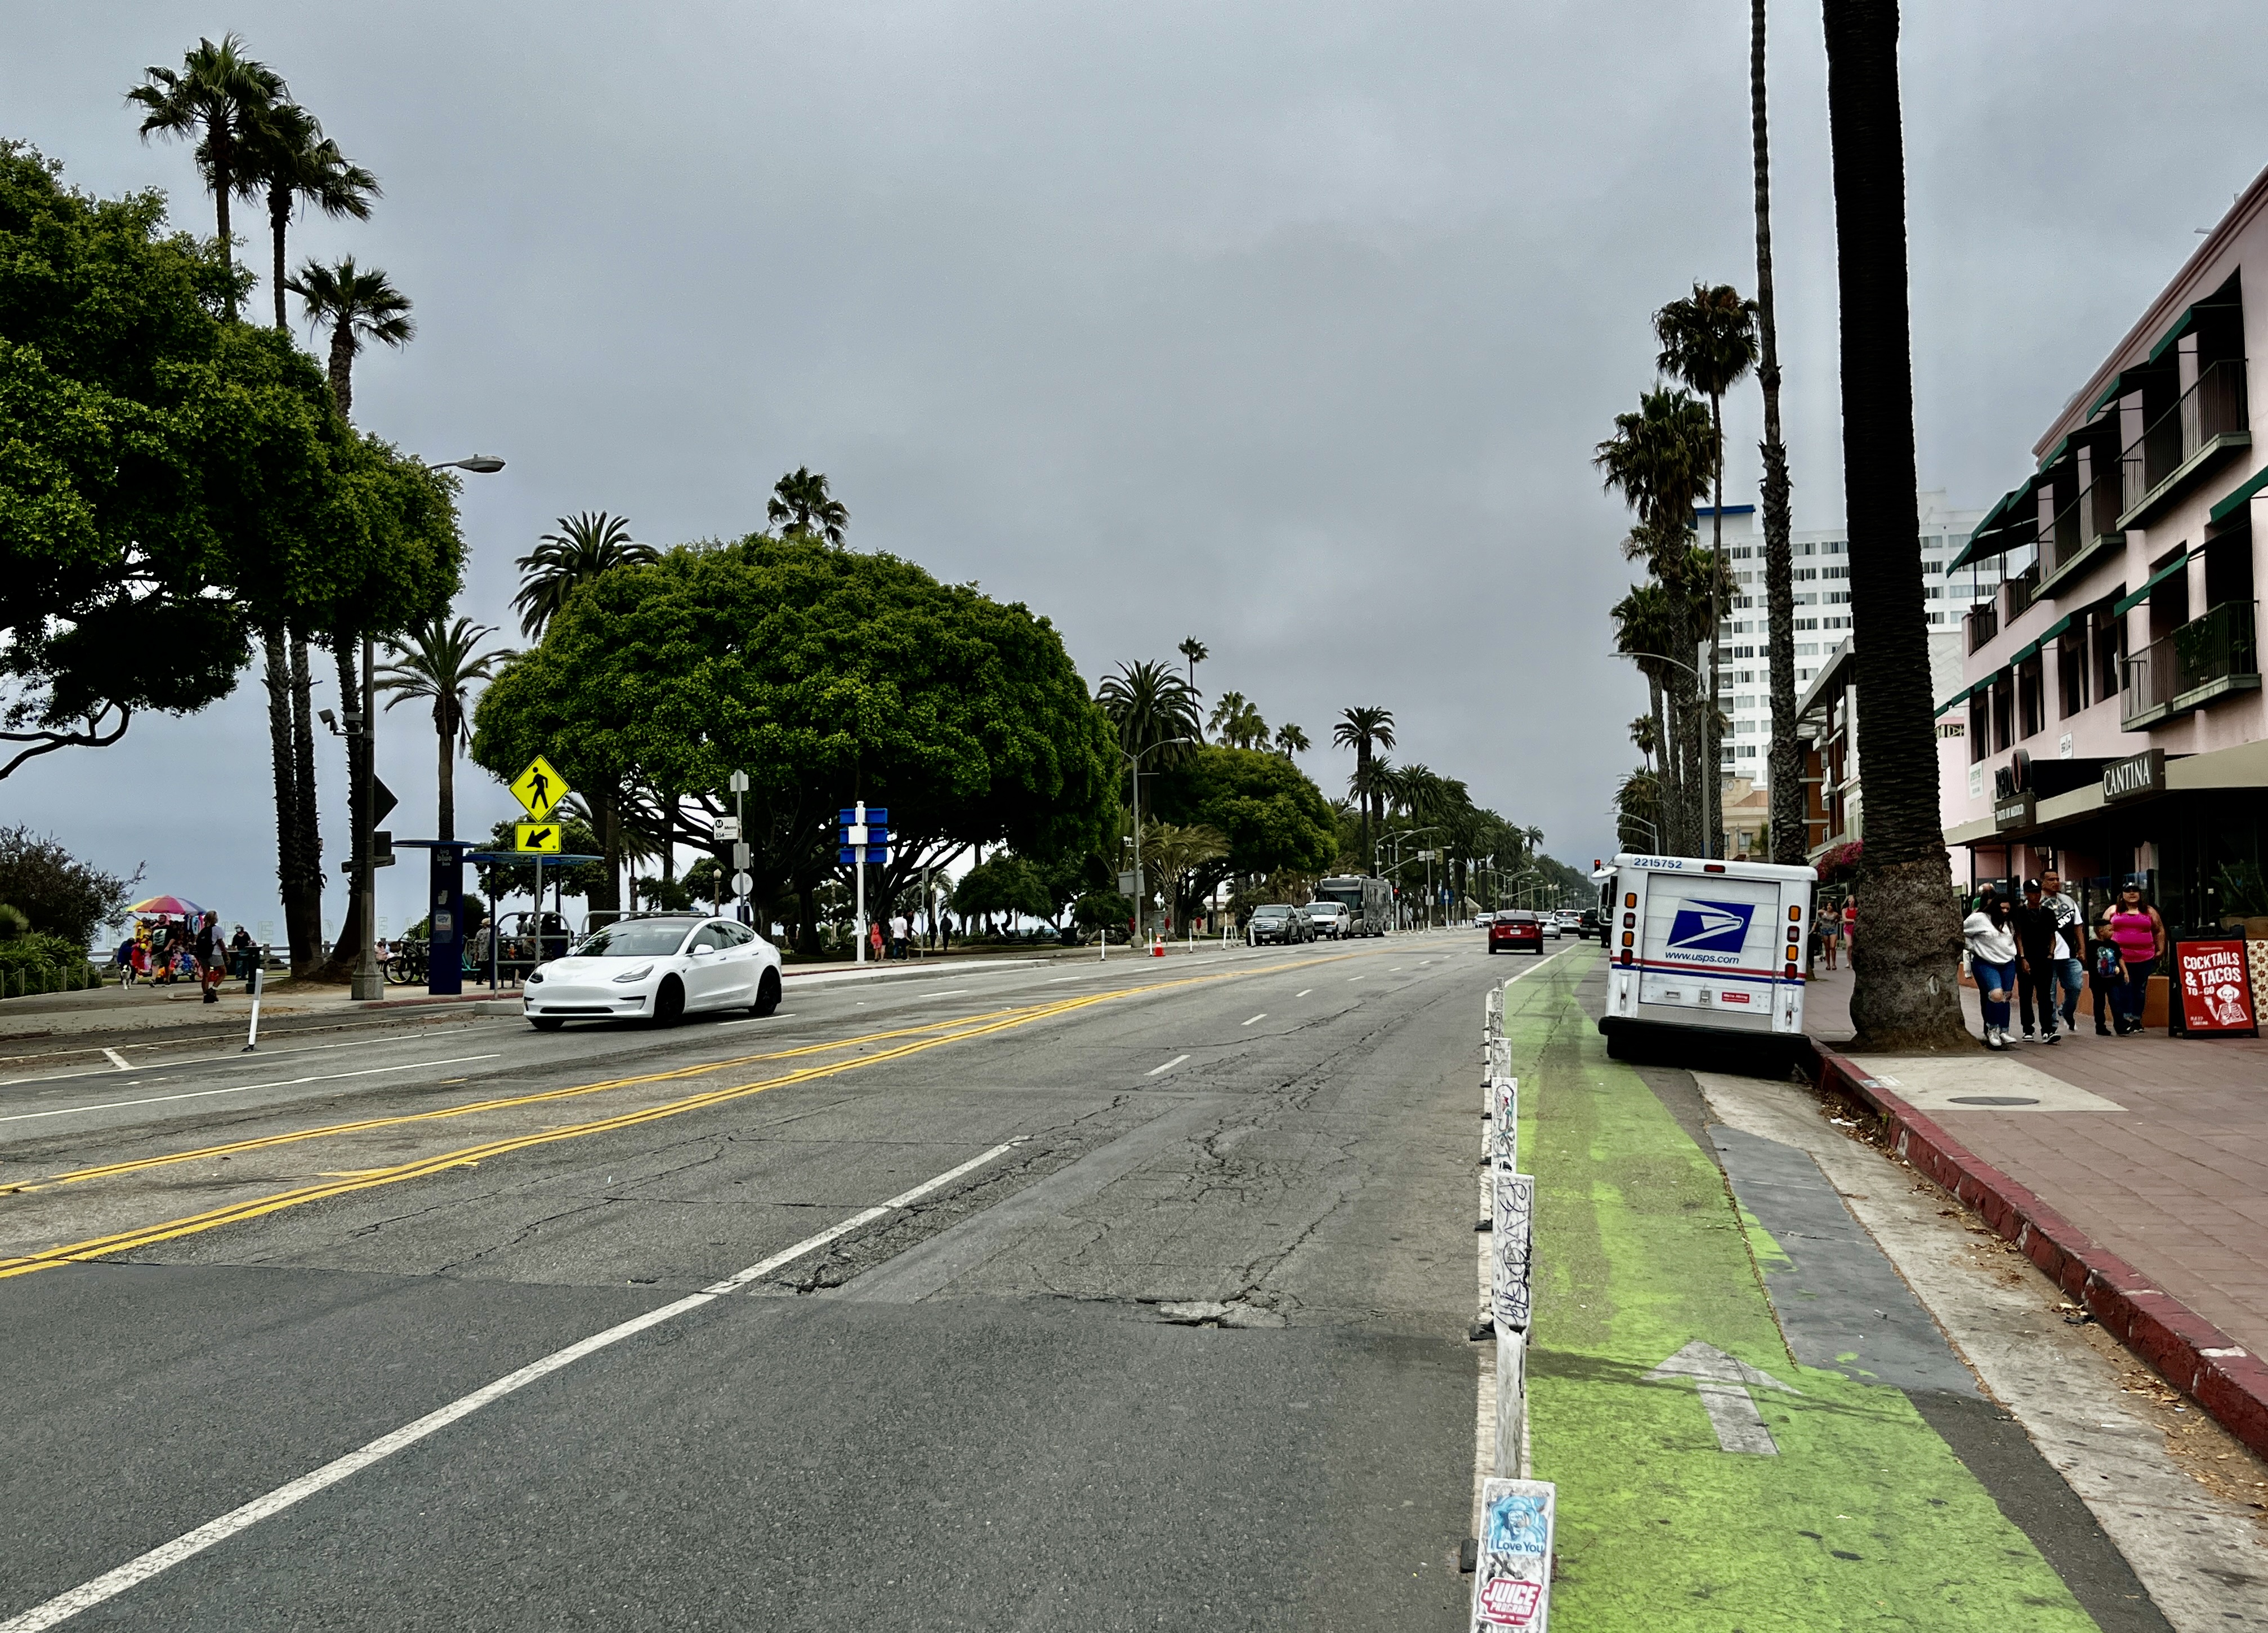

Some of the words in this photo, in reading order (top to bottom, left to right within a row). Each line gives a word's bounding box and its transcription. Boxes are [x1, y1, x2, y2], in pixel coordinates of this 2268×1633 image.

[2104, 757, 2151, 796] CANTINA
[1633, 858, 1682, 869] 2215752
[1665, 952, 1739, 964] www.usps.com
[2183, 952, 2240, 970] COCKTAILS
[2185, 971, 2197, 987] &
[2199, 966, 2242, 986] TACOS
[1490, 1538, 1493, 1549] I
[1497, 1539, 1522, 1551] Love
[1523, 1541, 1543, 1552] You
[1484, 1581, 1539, 1607] JUICE
[1490, 1601, 1532, 1616] PROGRAM
